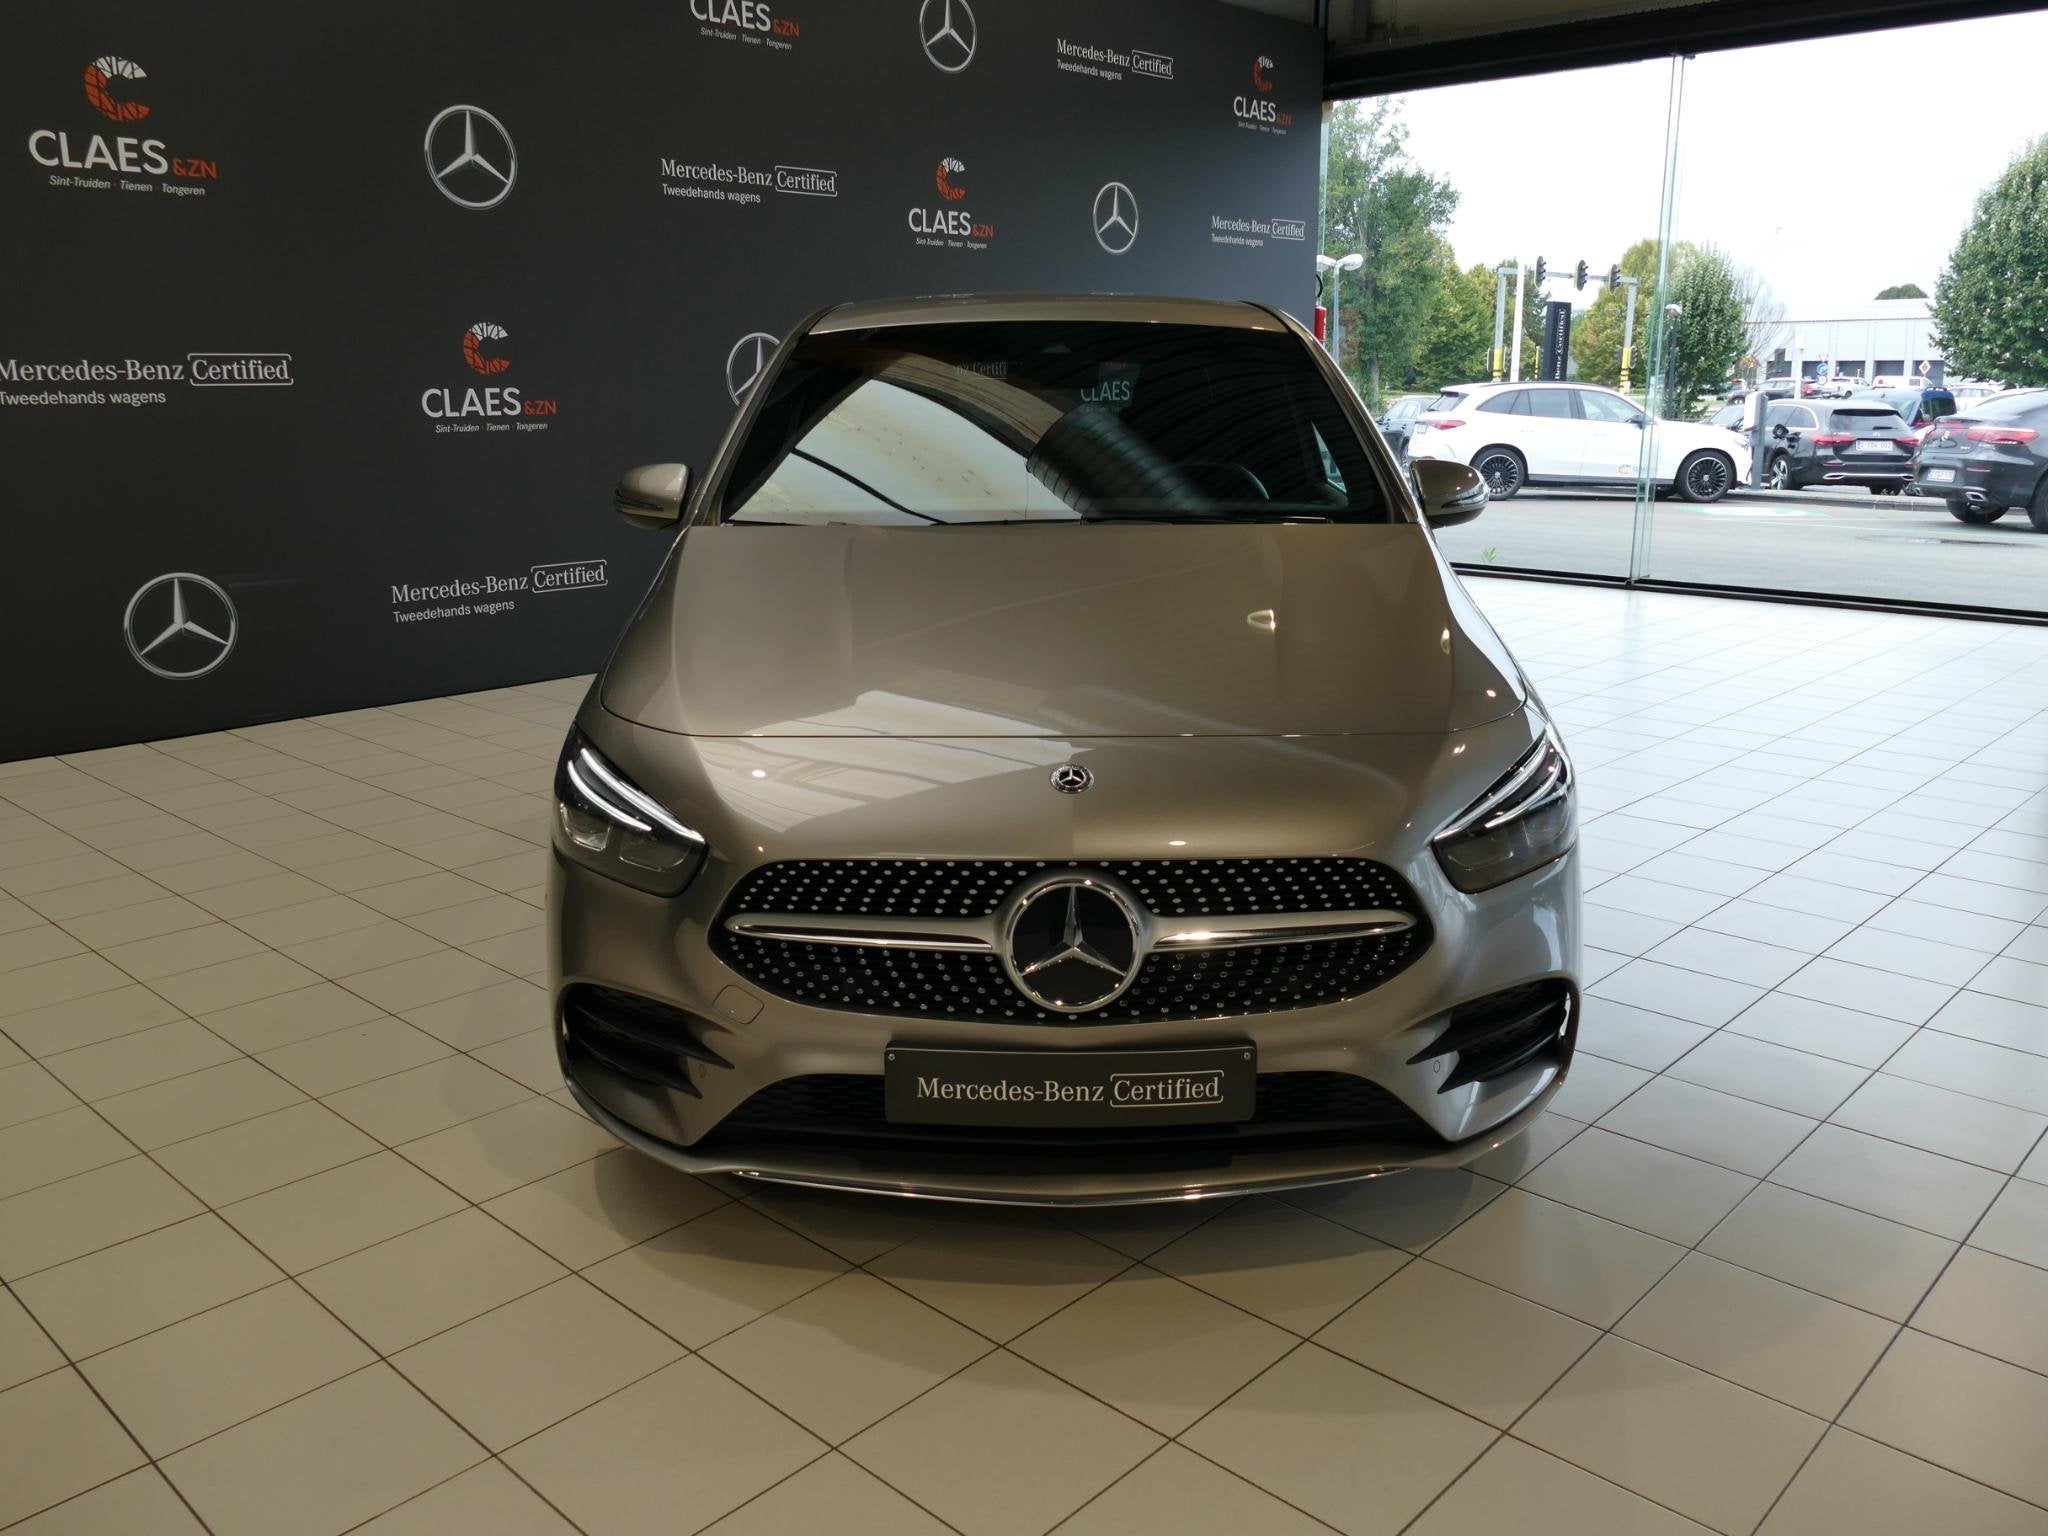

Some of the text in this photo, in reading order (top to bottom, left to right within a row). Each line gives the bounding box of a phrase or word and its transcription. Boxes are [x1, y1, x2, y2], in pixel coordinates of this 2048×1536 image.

[690, 0, 771, 31] CLAES
[1057, 38, 1172, 76] Mercedes-Benz Certified
[1233, 96, 1276, 122] CLAES
[28, 128, 168, 175] CLAES
[49, 175, 206, 196] Sint-Truiden Tienen Tongeren
[661, 158, 836, 192] Mercedes-Benz Certified
[663, 184, 761, 204] Tweedehands wagens
[908, 208, 971, 236] CLAES
[1212, 216, 1304, 237] Mercedes-Benz Certified
[0, 359, 289, 382] Mercedes-Benz Certified
[0, 390, 166, 407] Tweedehands wagens
[421, 387, 522, 418] CLAES
[436, 424, 479, 433] Sint-Truiden
[516, 422, 548, 432] Tongeren
[391, 565, 605, 604] Mercedes-Benz Certified
[394, 601, 515, 623] Tweedehands wagens
[916, 1077, 1220, 1102] Mercedes-Benz Certified
